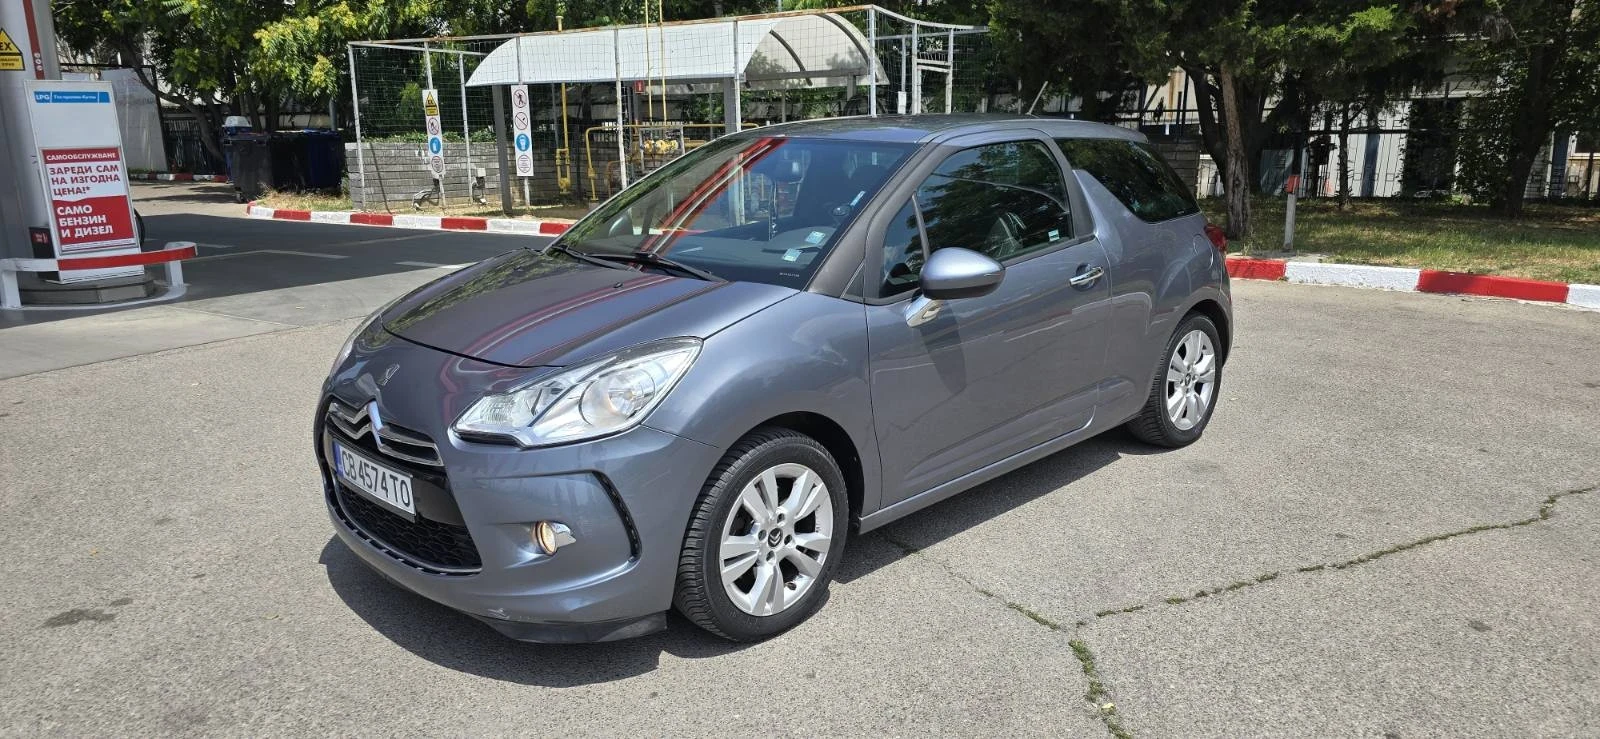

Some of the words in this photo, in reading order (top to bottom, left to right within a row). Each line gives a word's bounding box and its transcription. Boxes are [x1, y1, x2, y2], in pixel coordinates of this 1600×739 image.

[46, 152, 116, 161] САМООБСЛУЖВАНЕ
[49, 165, 93, 175] ЗАРЕДИ
[96, 164, 119, 173] САМ
[52, 177, 67, 185] НА
[70, 174, 120, 184] ИЗГОДНА
[57, 205, 93, 216] САМО
[59, 215, 107, 227] БЕНЗИН
[61, 229, 71, 238] И
[74, 225, 114, 238] ДИЗЕЛ
[341, 450, 357, 481] CB
[358, 460, 389, 498] 4574
